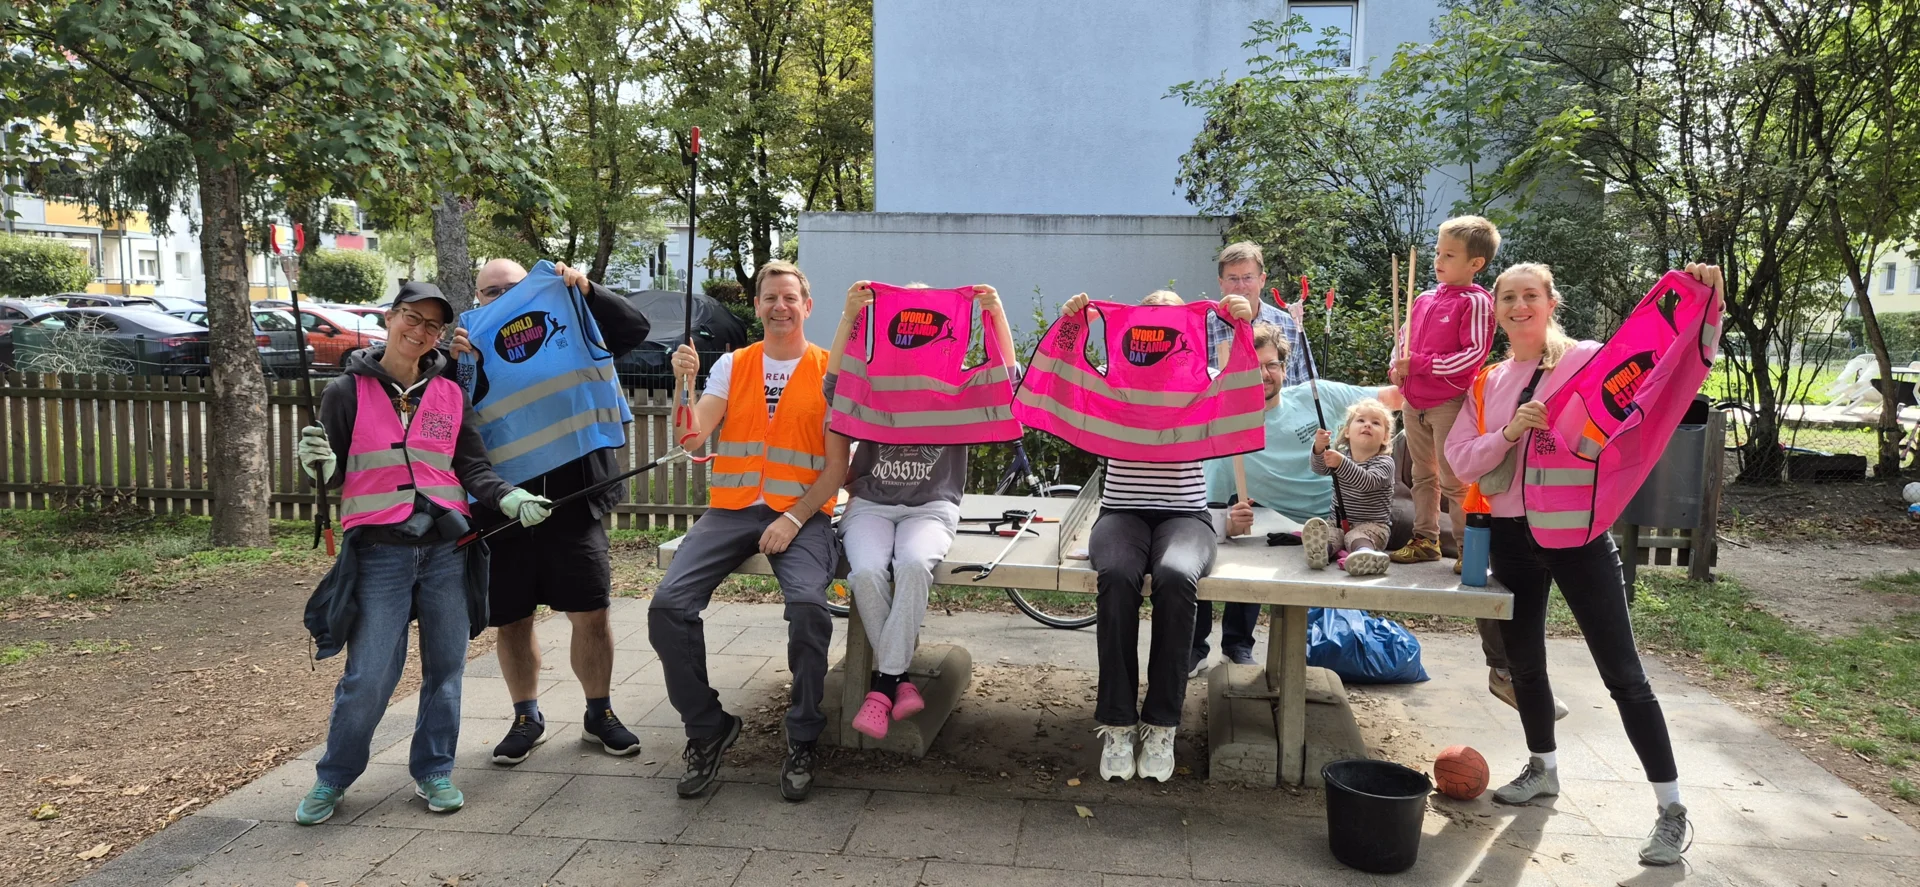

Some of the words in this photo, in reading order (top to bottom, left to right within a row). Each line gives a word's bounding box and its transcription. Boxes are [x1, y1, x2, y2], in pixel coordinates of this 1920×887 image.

[900, 311, 933, 325] WORLD
[500, 316, 533, 338] WORLD
[897, 322, 939, 337] CLEANUP
[1131, 327, 1165, 342] WORLD
[503, 325, 544, 349] CLEANUP
[895, 333, 914, 346] DAY
[507, 344, 527, 361] DAY
[1130, 339, 1172, 353] CLEANUP
[1128, 350, 1147, 363] DAY
[1603, 361, 1642, 395] WORLD
